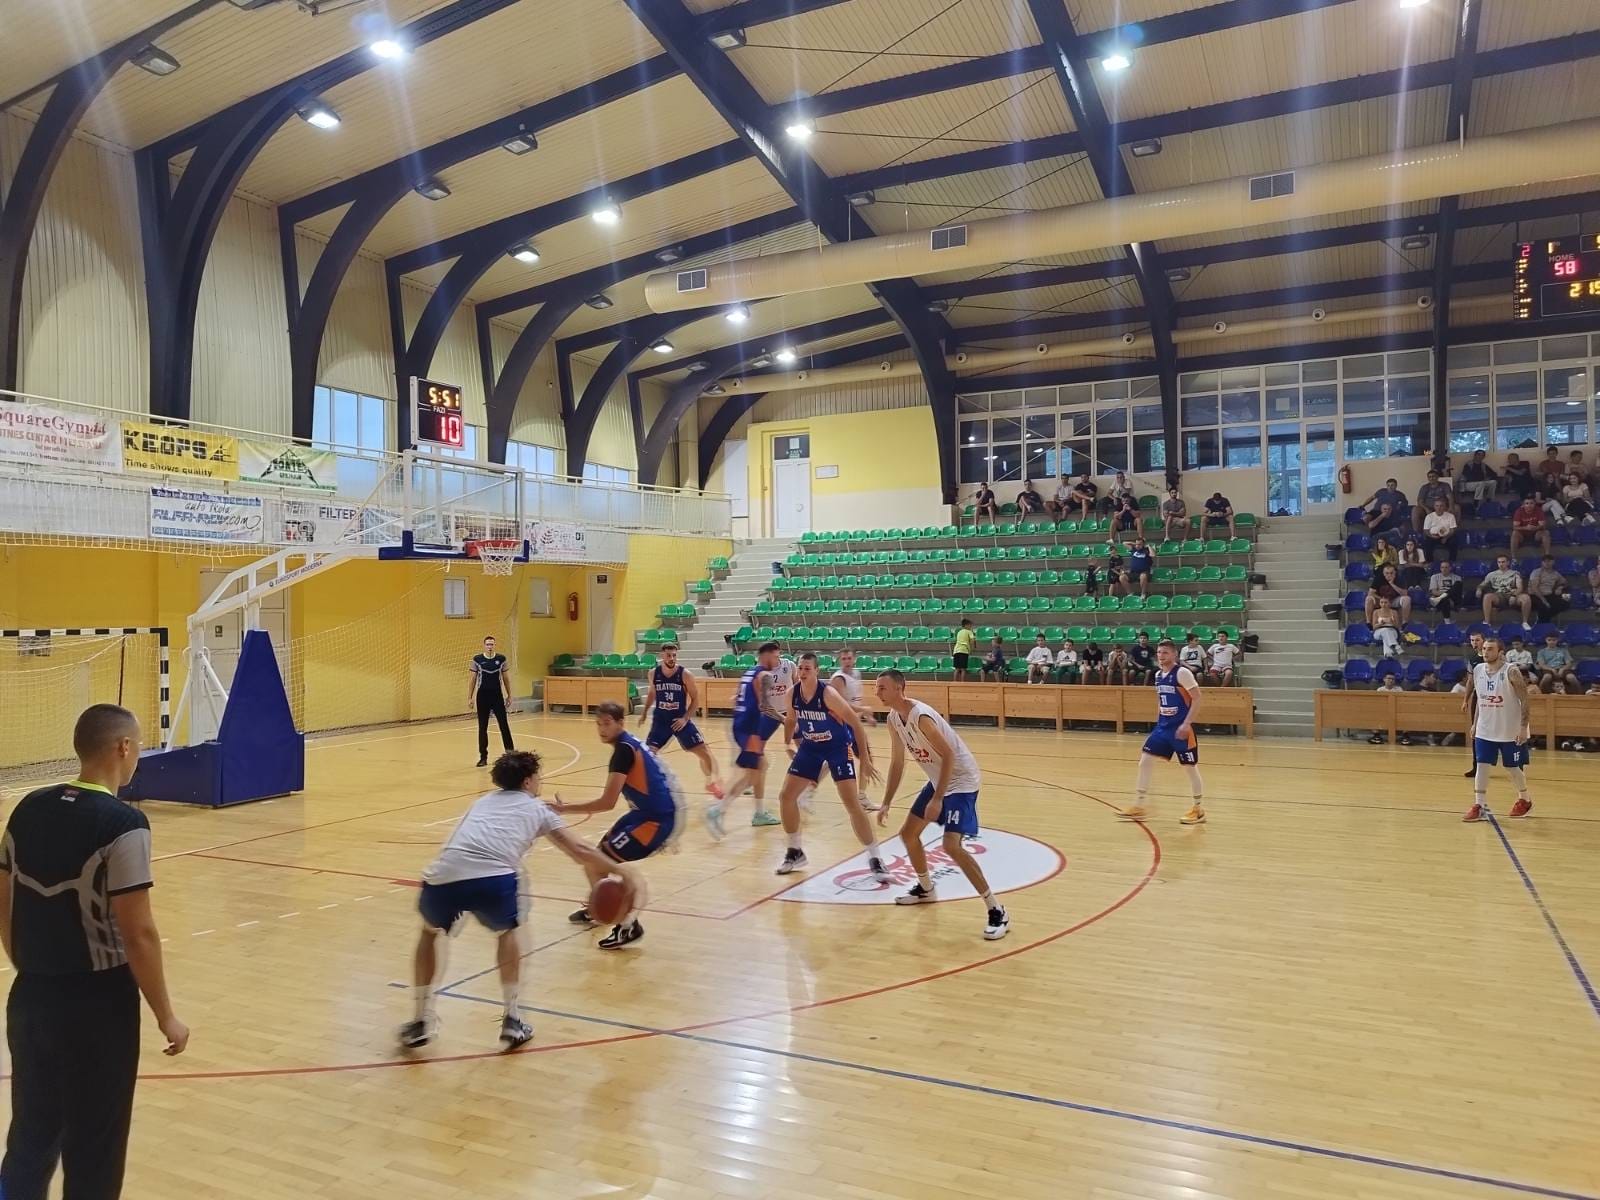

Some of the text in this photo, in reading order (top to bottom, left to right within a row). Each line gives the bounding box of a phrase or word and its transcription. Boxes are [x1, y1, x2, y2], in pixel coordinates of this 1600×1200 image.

[1548, 253, 1575, 262] HOME
[1554, 260, 1576, 275] 58
[429, 386, 459, 407] 5:51
[440, 416, 460, 443] 10
[123, 429, 208, 460] KEOPS
[125, 457, 148, 469] Time
[150, 461, 180, 473] shows
[182, 467, 213, 478] quality
[1487, 681, 1494, 691] 15
[807, 721, 815, 732] 3
[847, 762, 854, 776] 3
[946, 810, 960, 825] 14
[611, 831, 631, 850] 13
